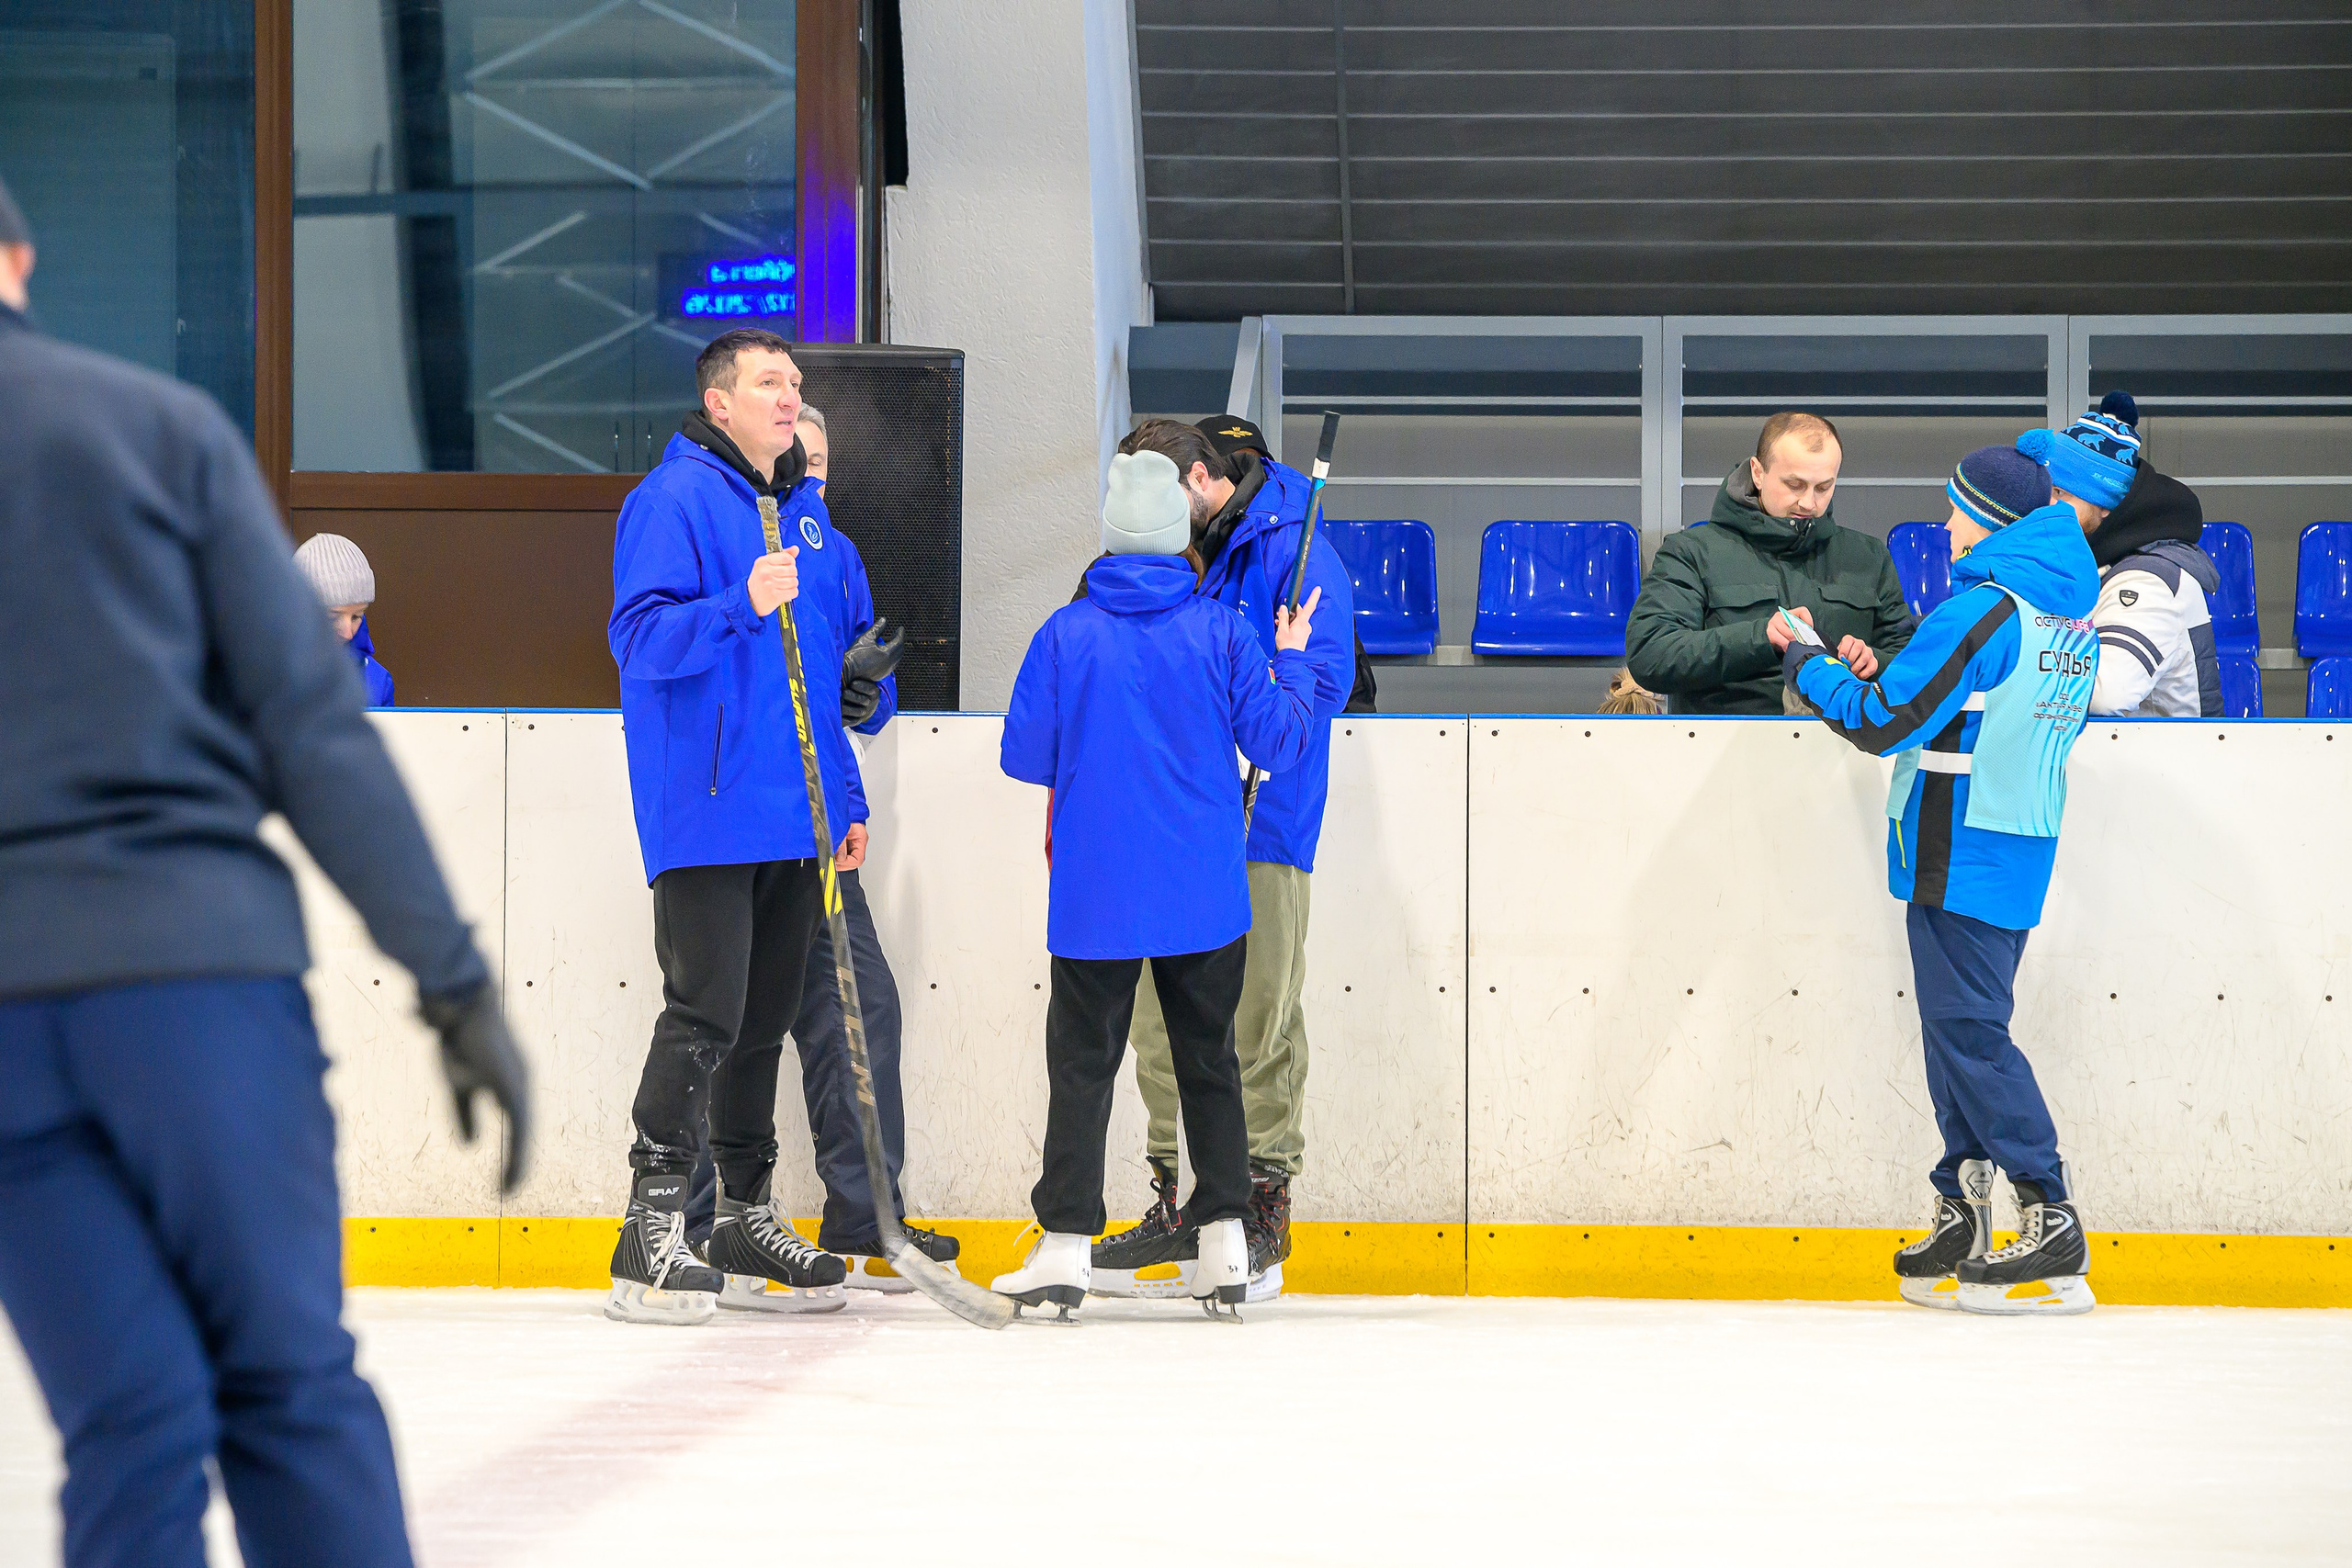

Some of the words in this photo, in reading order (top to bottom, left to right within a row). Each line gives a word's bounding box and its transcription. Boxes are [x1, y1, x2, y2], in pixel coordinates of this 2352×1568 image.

[2039, 649, 2092, 678] СУДЬЯ
[788, 677, 808, 743] SUPER
[648, 1186, 680, 1197] GRAF
